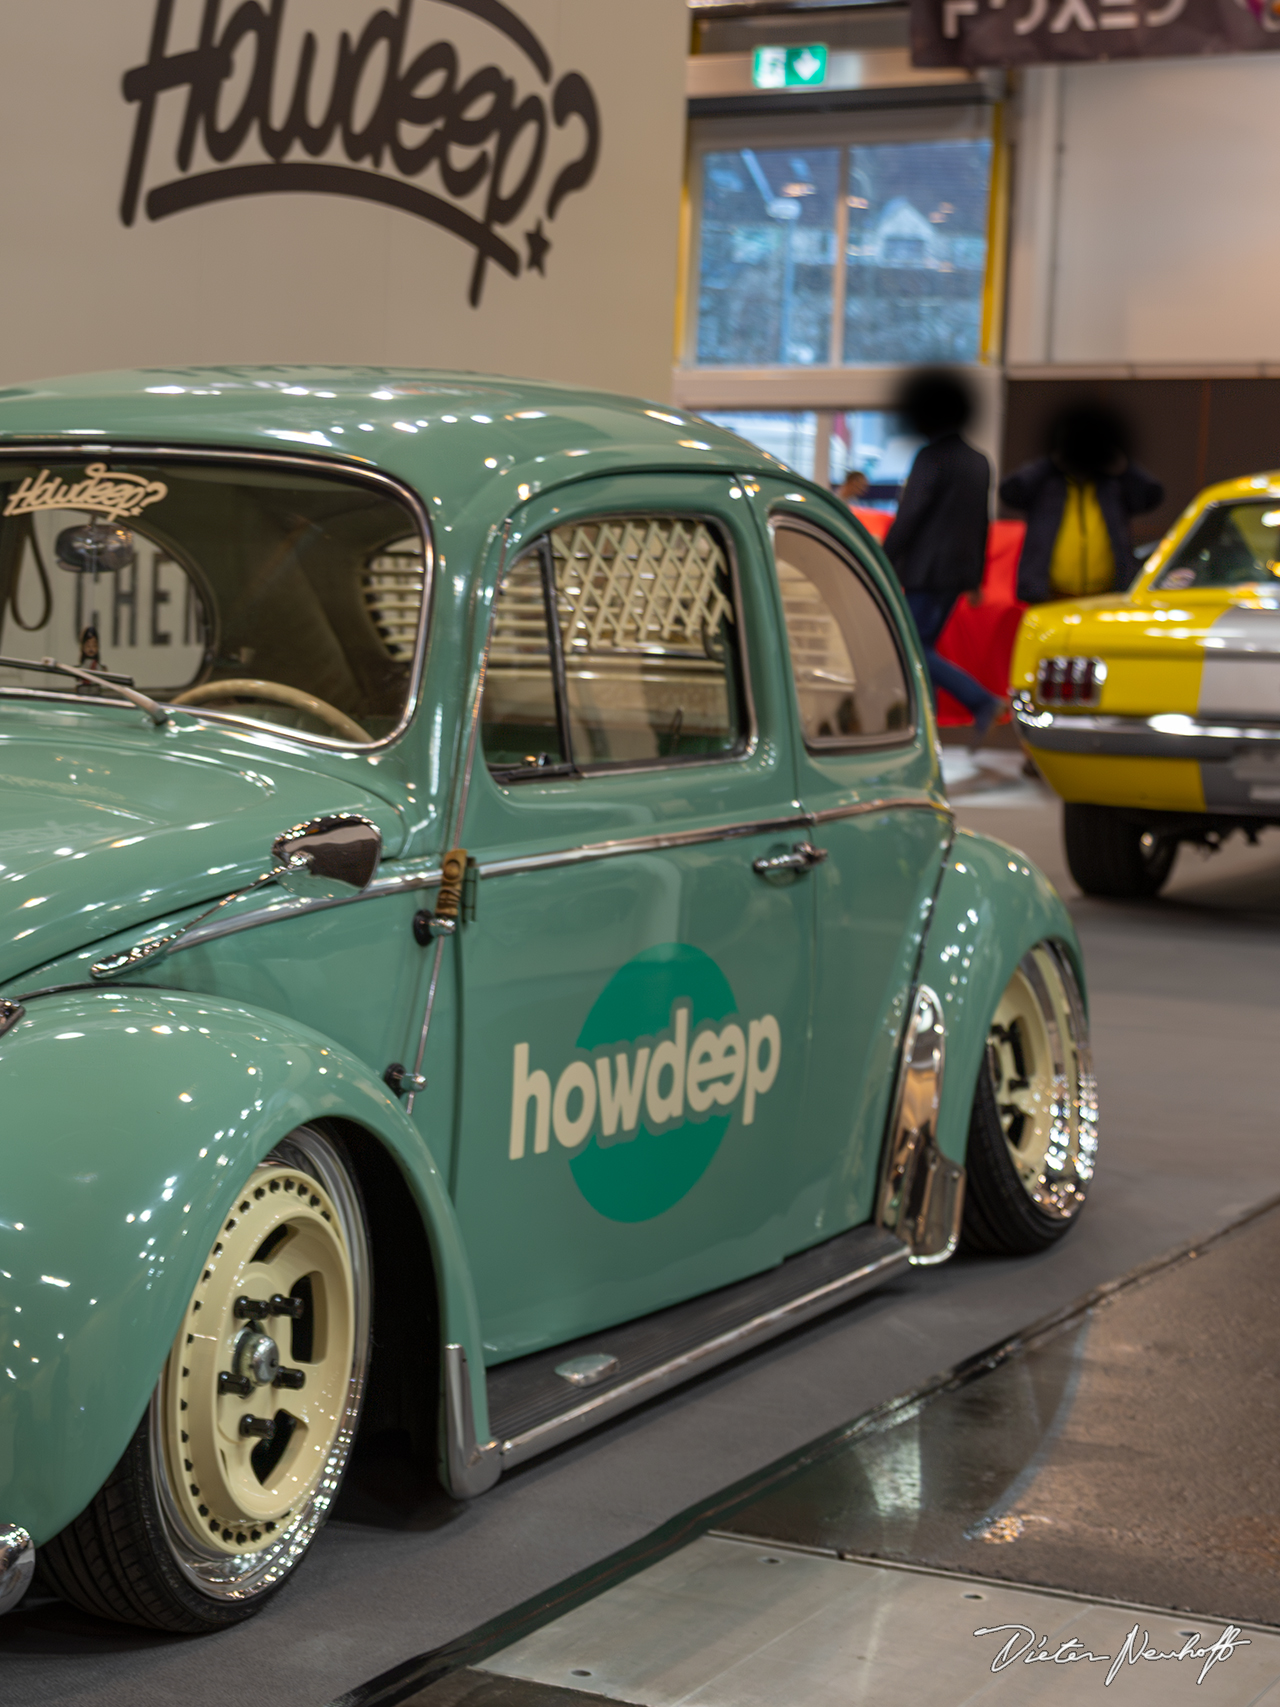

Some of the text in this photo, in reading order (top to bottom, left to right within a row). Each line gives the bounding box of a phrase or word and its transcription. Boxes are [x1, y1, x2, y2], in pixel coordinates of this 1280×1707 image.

[121, 0, 600, 308] Howdeep?
[2, 461, 169, 522] Howdeep?
[508, 1007, 782, 1161] howdeep
